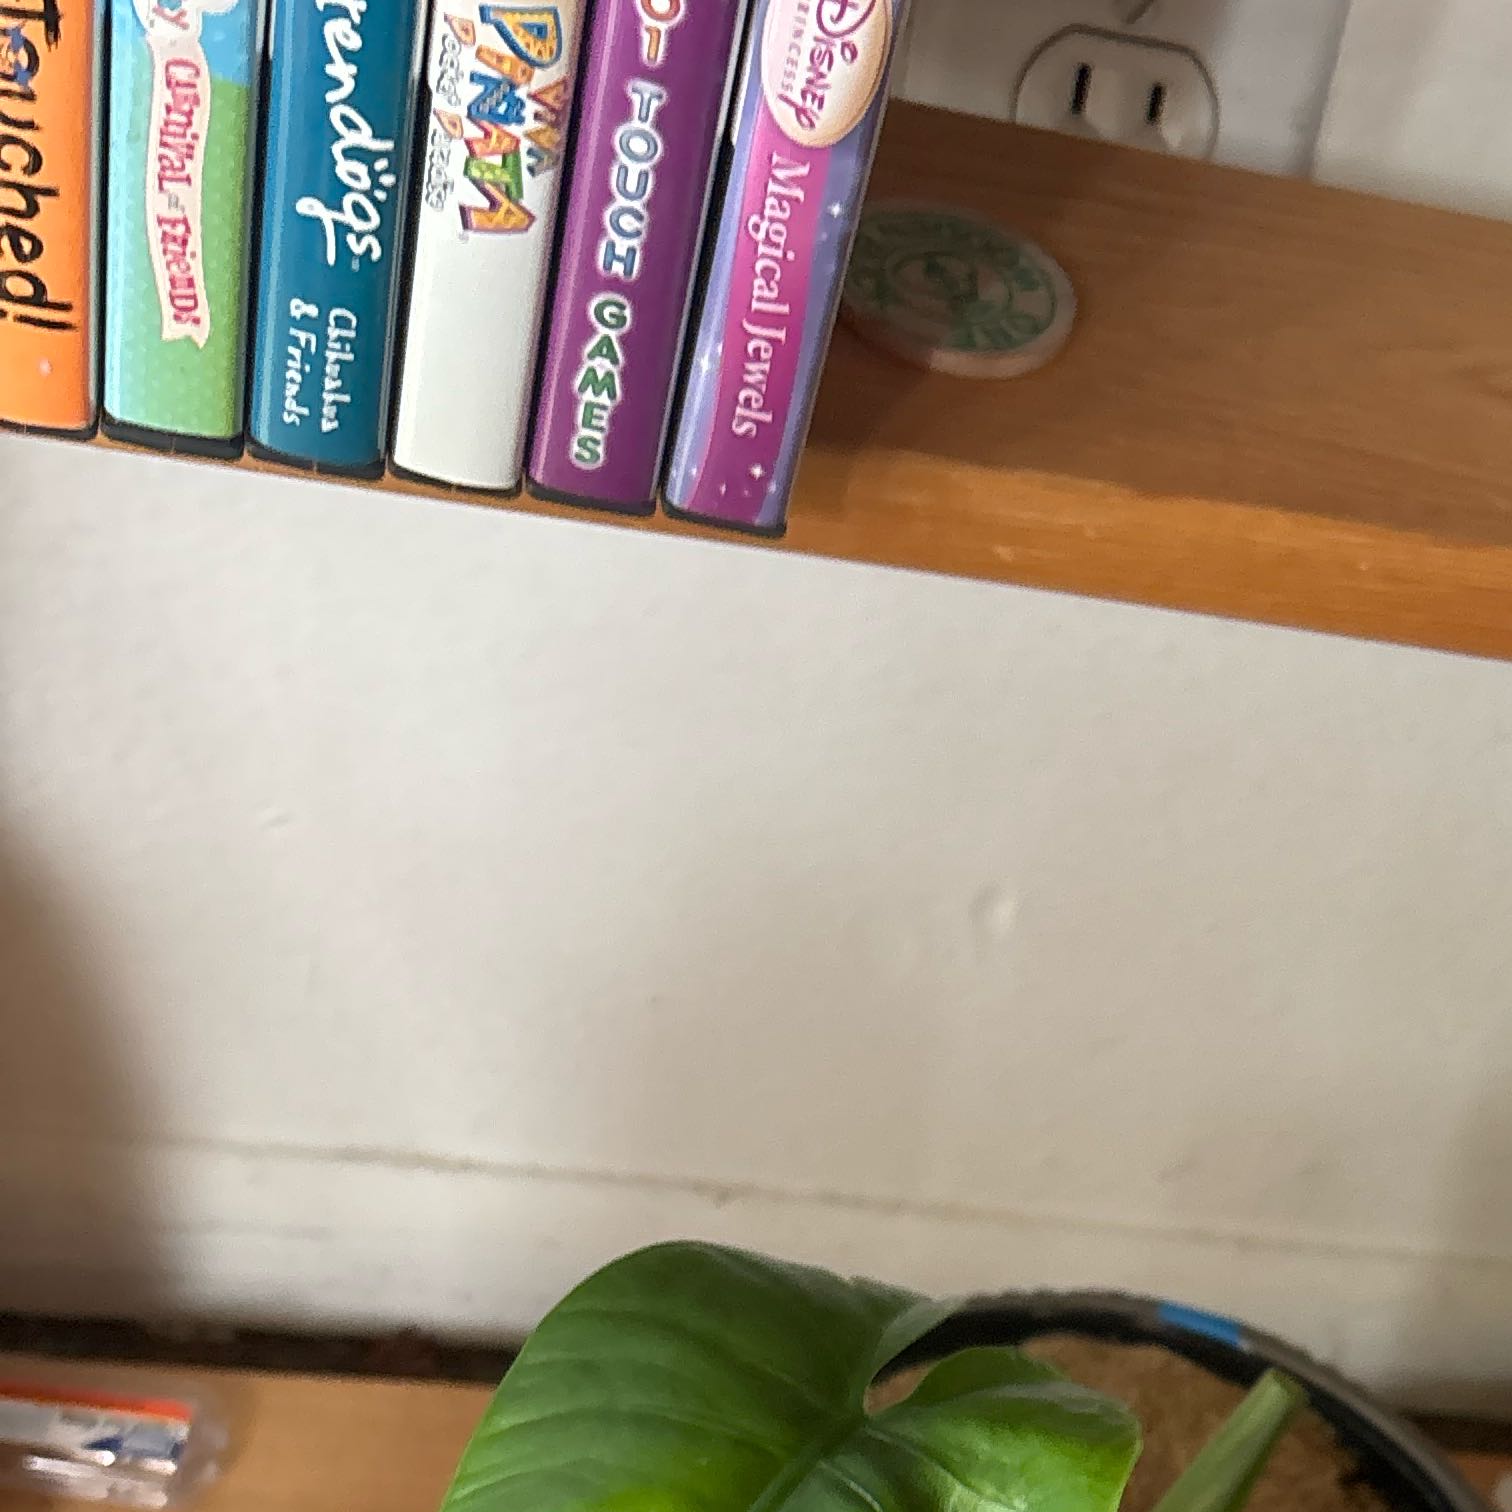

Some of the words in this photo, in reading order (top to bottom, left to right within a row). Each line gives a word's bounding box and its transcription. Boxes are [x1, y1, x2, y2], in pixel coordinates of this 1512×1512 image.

[602, 83, 665, 277] TOUCH
[746, 153, 811, 317] Magical
[283, 325, 317, 427] Friends
[289, 298, 319, 320] &
[732, 317, 787, 440] Jewels
[574, 299, 628, 466] GAMES
